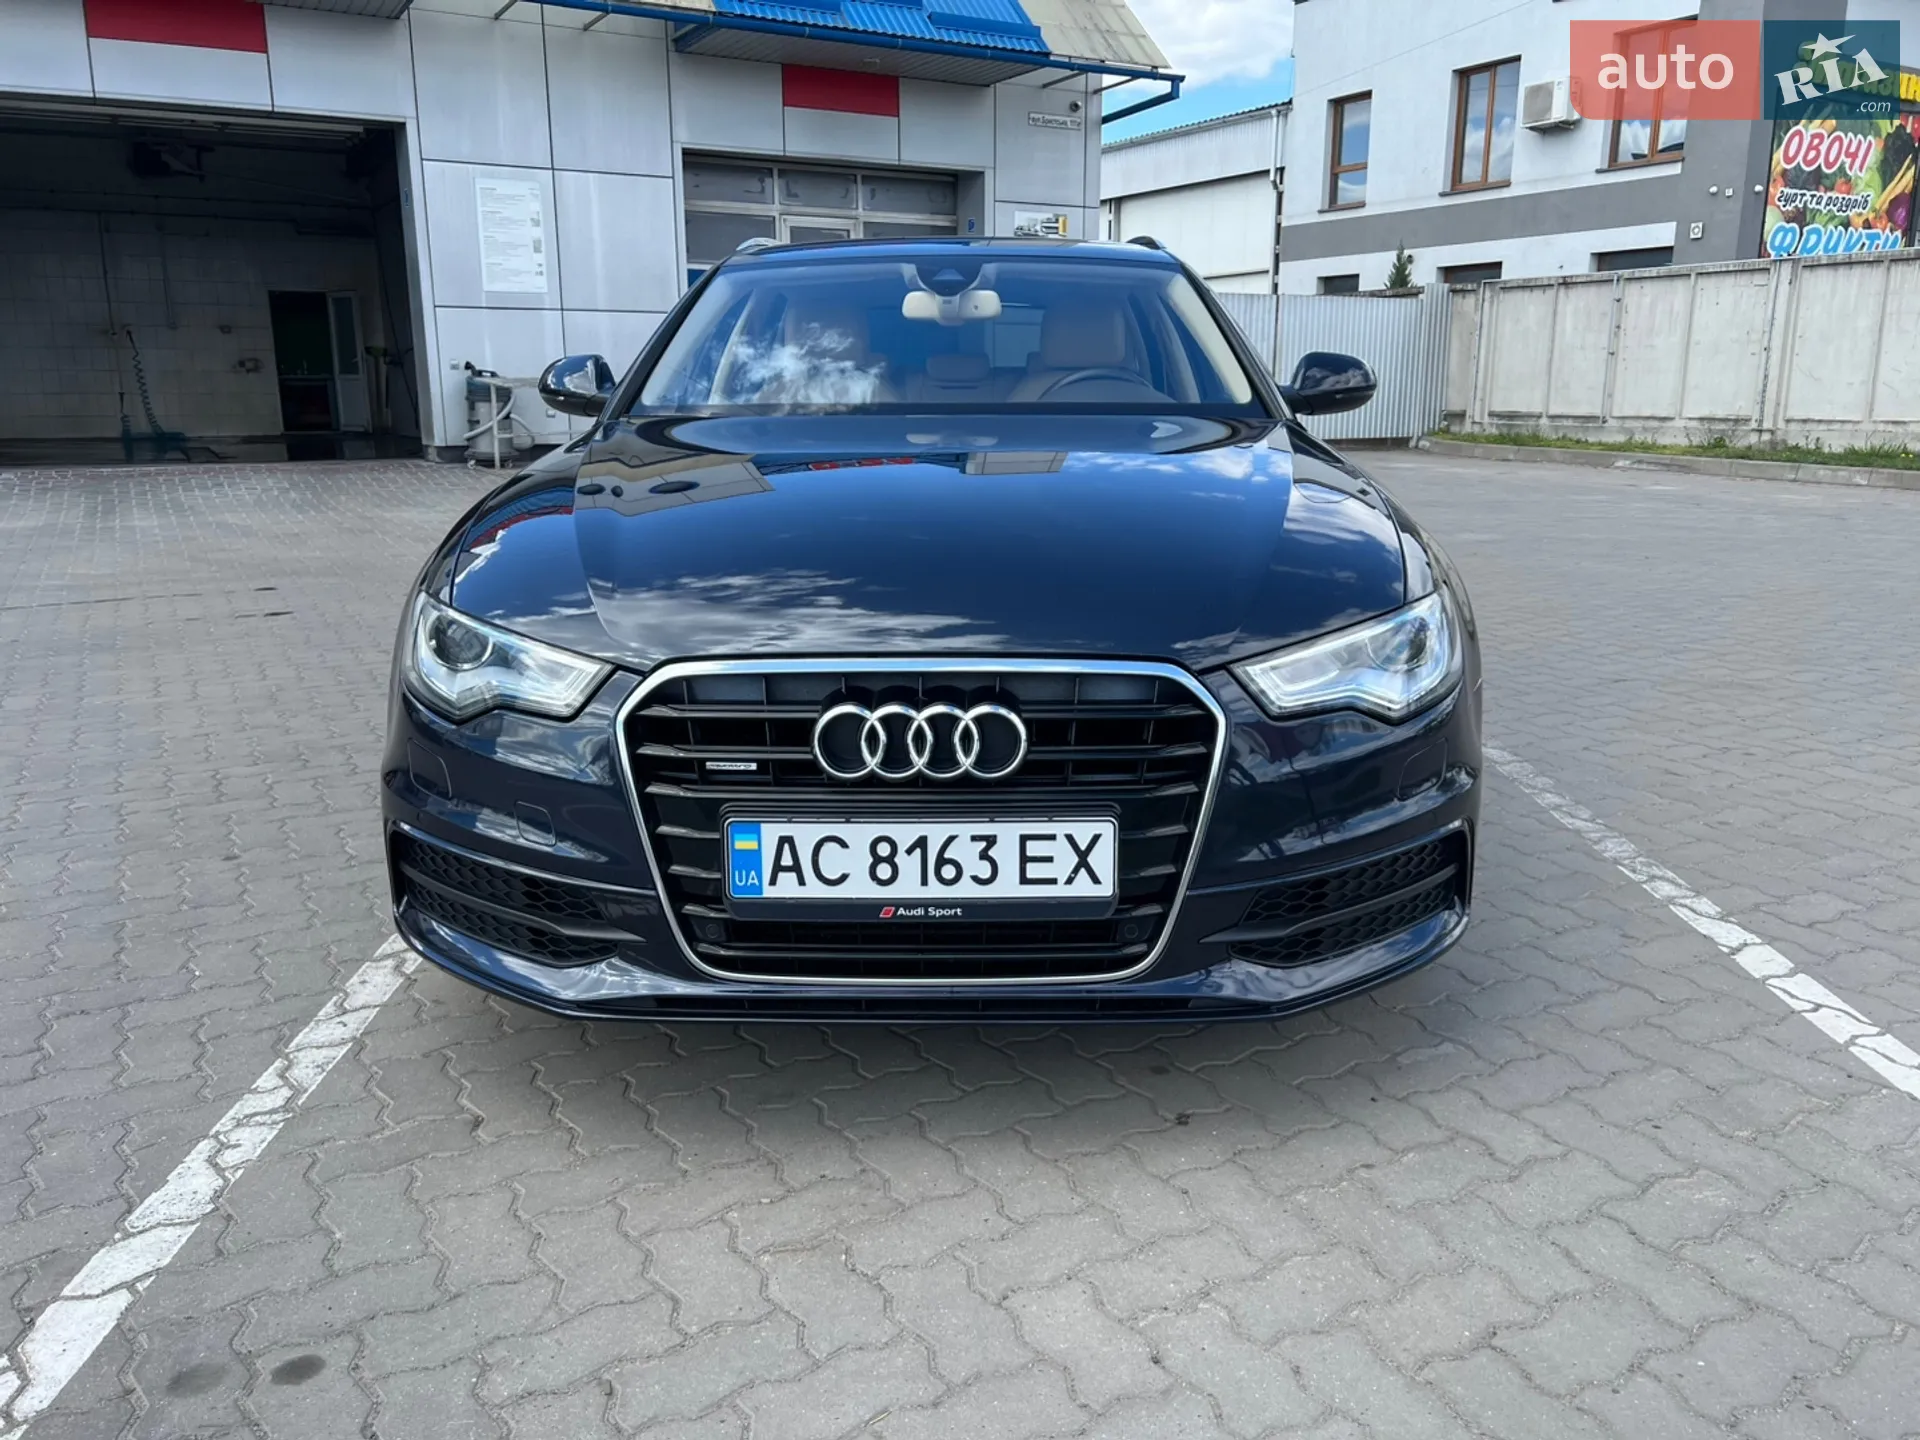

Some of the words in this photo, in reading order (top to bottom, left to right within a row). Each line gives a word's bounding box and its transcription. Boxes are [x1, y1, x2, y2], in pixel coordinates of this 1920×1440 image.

[1782, 127, 1874, 174] ОВОЧІ
[1777, 190, 1808, 208] гурт
[1809, 193, 1823, 206] та
[1824, 194, 1870, 213] роздріб
[768, 834, 851, 887] AC
[868, 834, 999, 887] 8163
[1018, 833, 1103, 886] EX
[735, 870, 759, 886] UA
[897, 906, 925, 916] Audi
[928, 906, 962, 918] Sport
